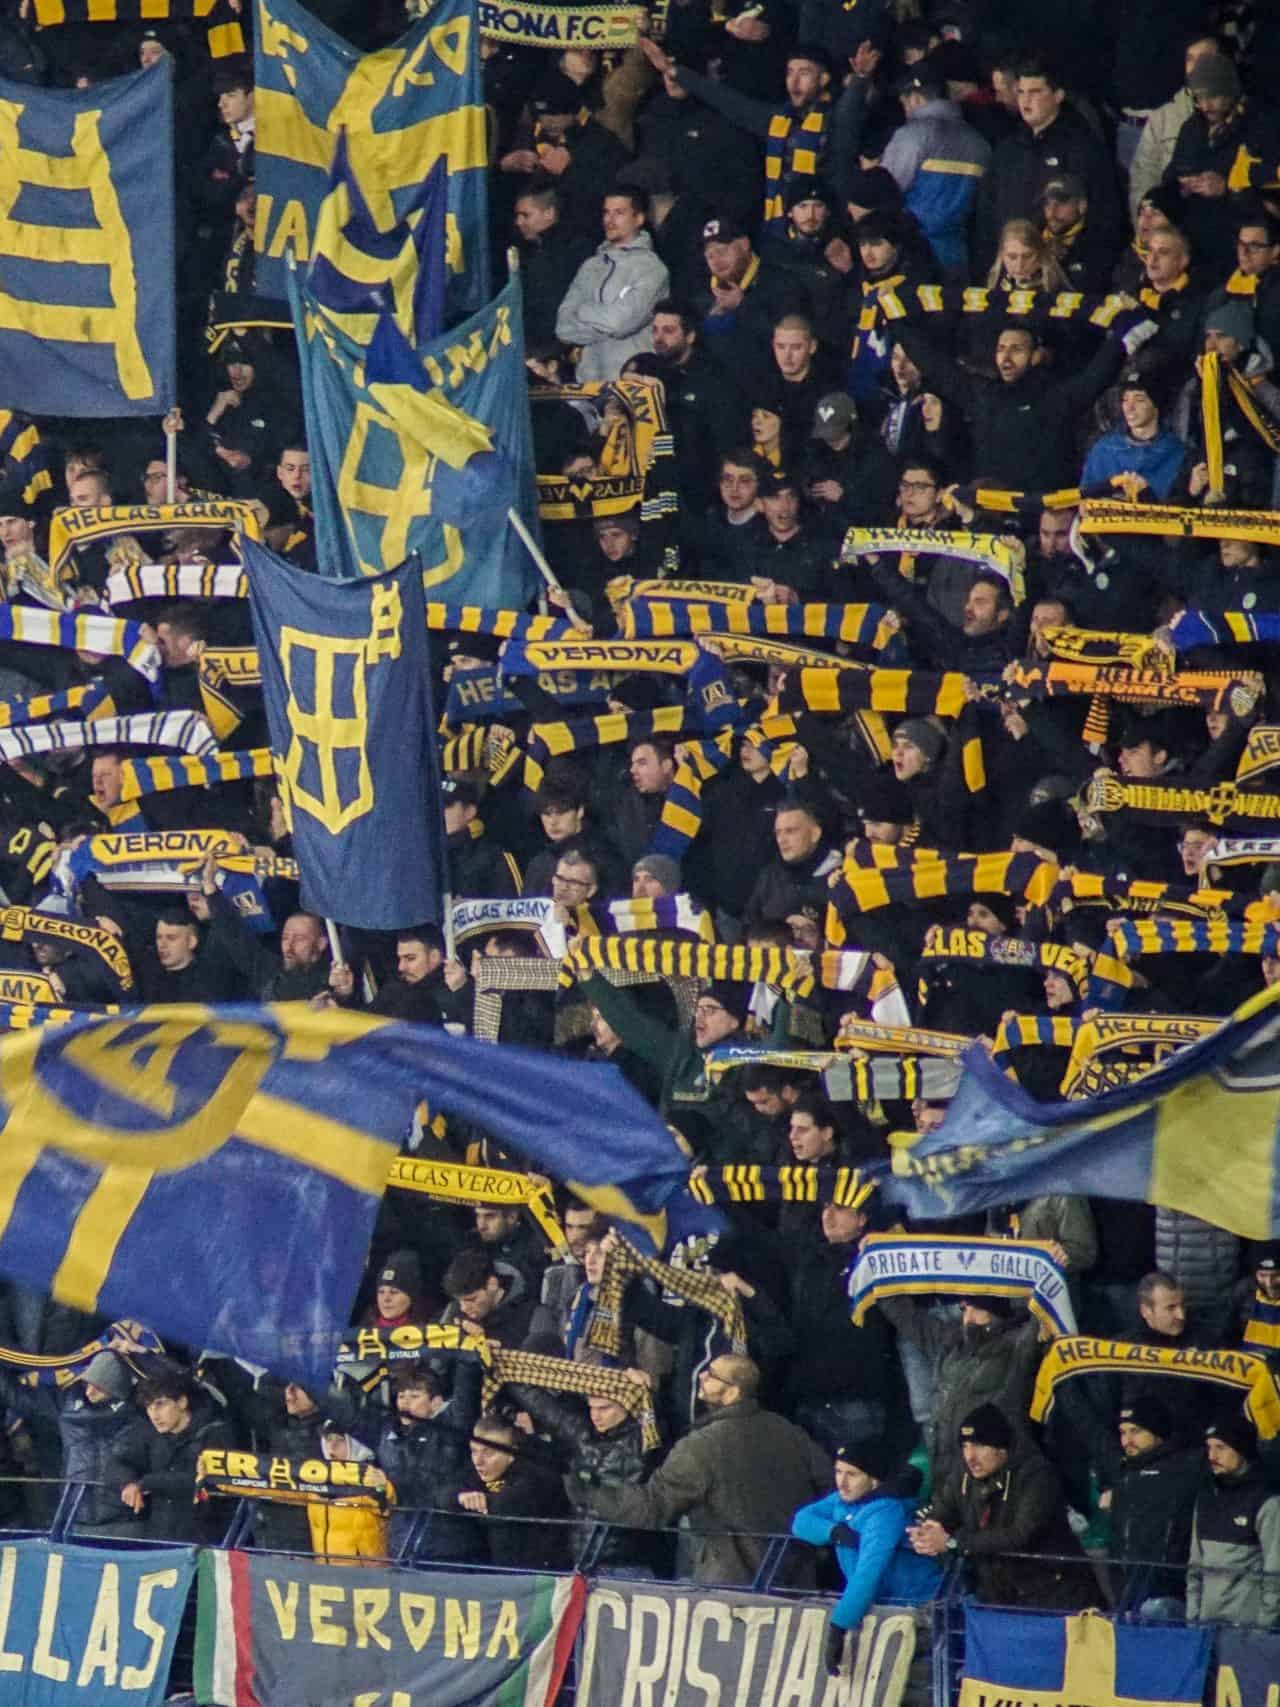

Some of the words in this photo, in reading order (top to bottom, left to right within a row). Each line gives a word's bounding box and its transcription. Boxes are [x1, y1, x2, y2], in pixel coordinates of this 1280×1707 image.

[61, 505, 161, 531] HELLAS
[541, 645, 683, 665] VERONA
[101, 833, 229, 855] VERONA
[506, 900, 551, 918] ARMY
[25, 916, 120, 958] VERONA
[1095, 1018, 1201, 1039] HELLAS
[867, 1249, 943, 1275] BRIGATE
[990, 1253, 1064, 1299] GIALLLU
[1057, 1340, 1160, 1364] HELLAS
[1172, 1348, 1253, 1378] ARMY
[264, 1580, 519, 1661] VERONA
[584, 1592, 918, 1707] CRISTIANO
